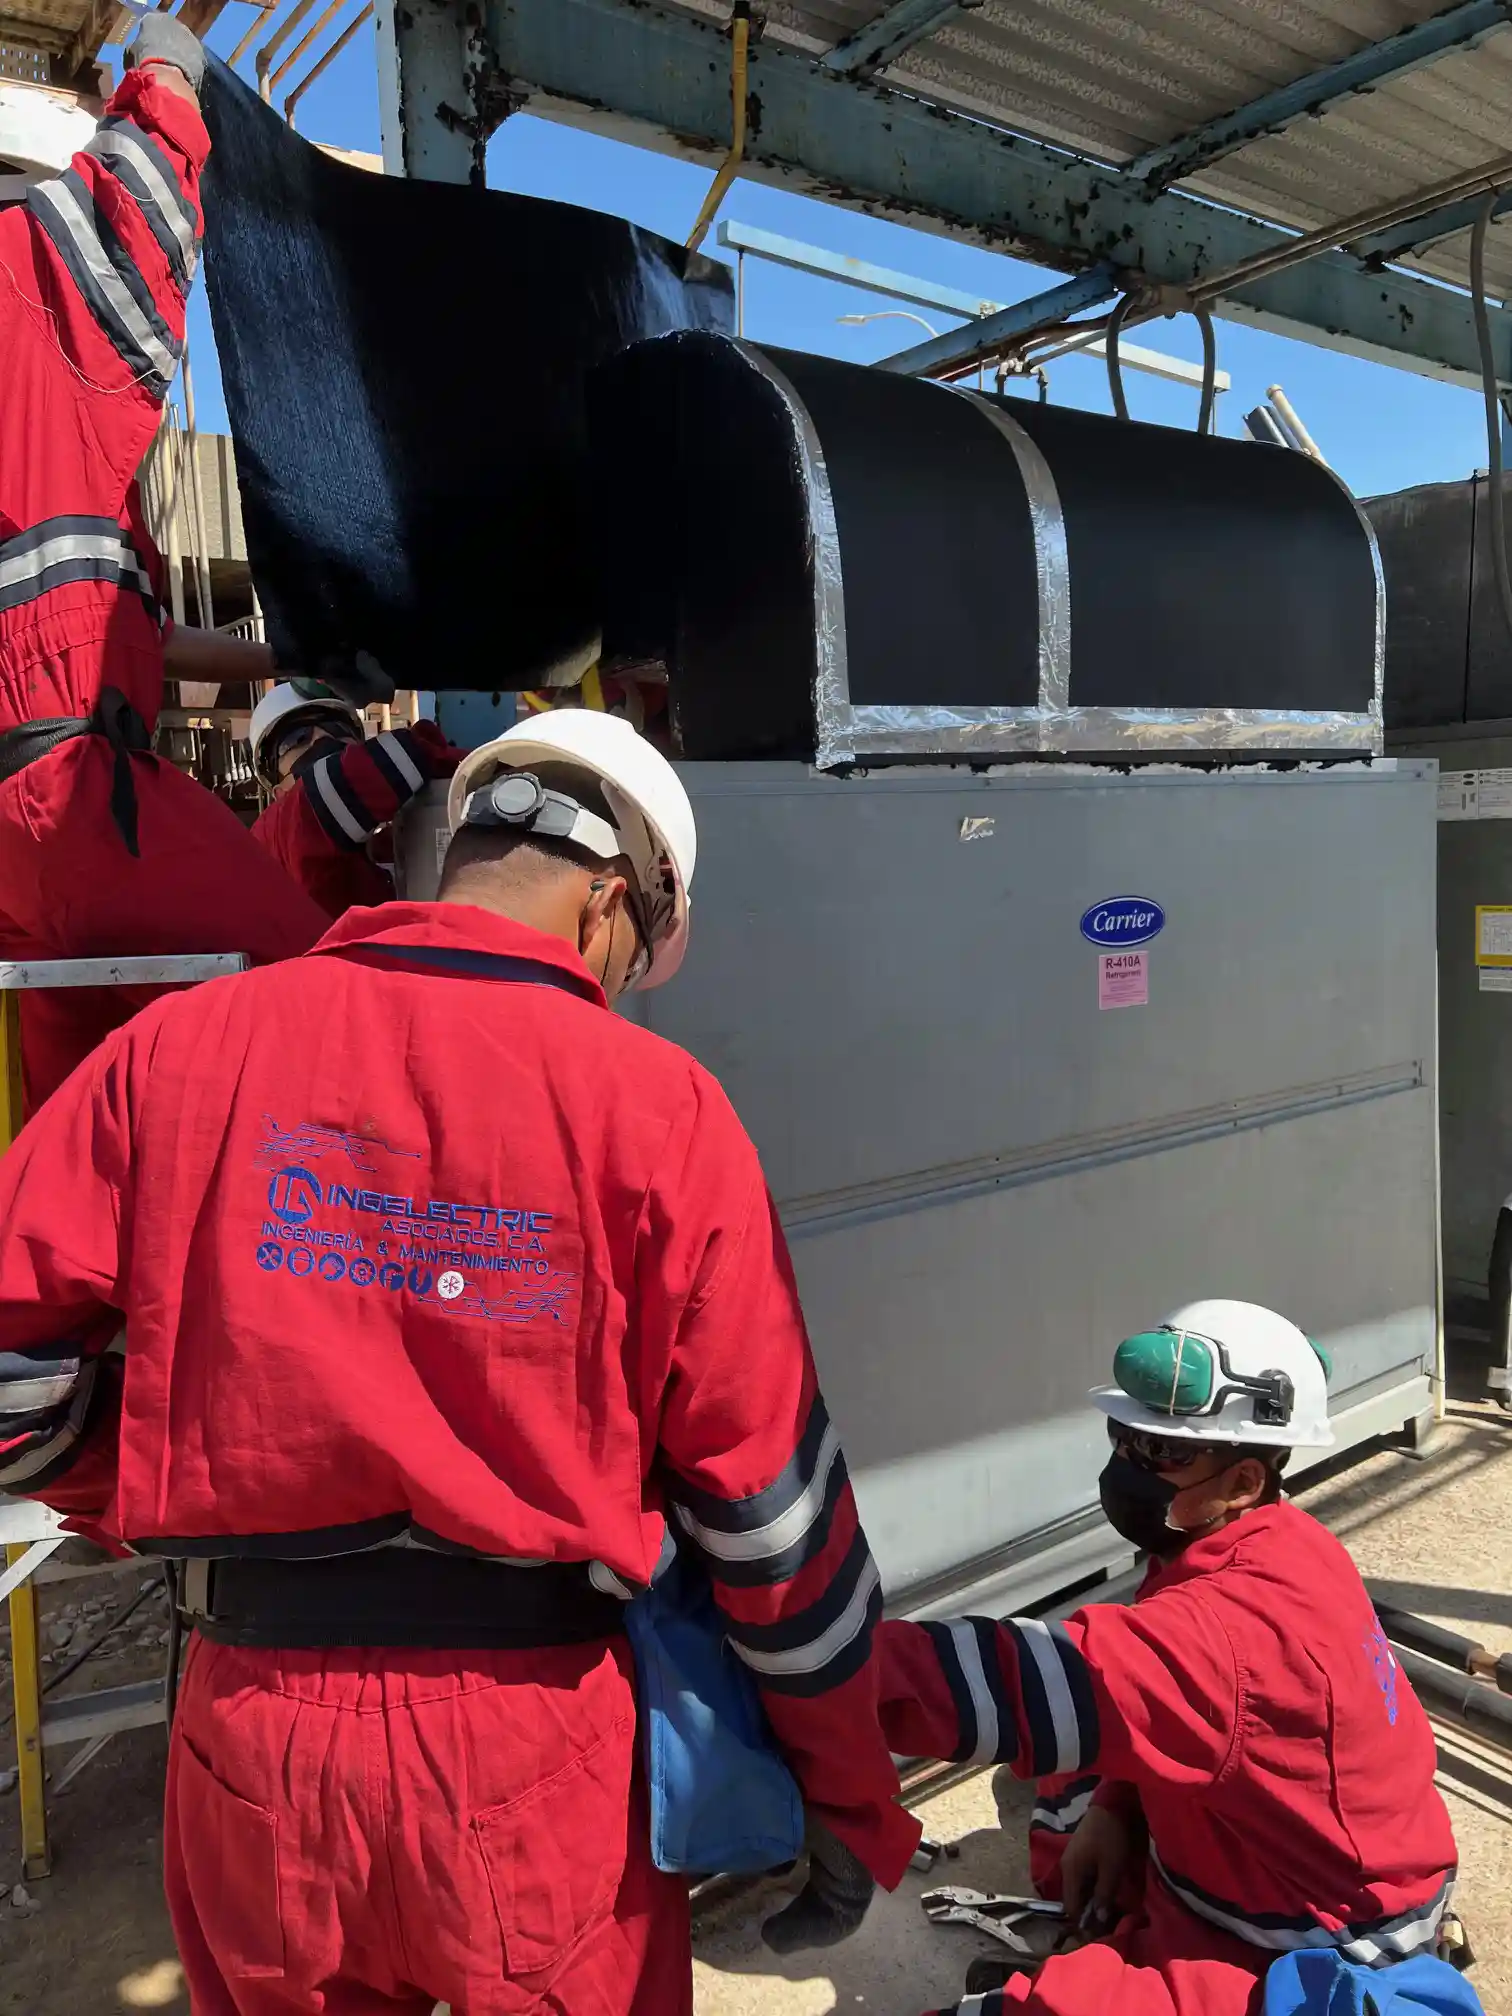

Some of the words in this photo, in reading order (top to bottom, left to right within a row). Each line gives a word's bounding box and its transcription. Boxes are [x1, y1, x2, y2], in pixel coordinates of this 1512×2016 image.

[1093, 908, 1155, 932] Carrier
[1106, 955, 1141, 969] R-410A
[327, 1183, 553, 1234] INGELECTRIC
[261, 1221, 364, 1252] INGENIERÍA
[376, 1240, 388, 1256] &
[399, 1244, 549, 1275] MANTENIMIENTO
